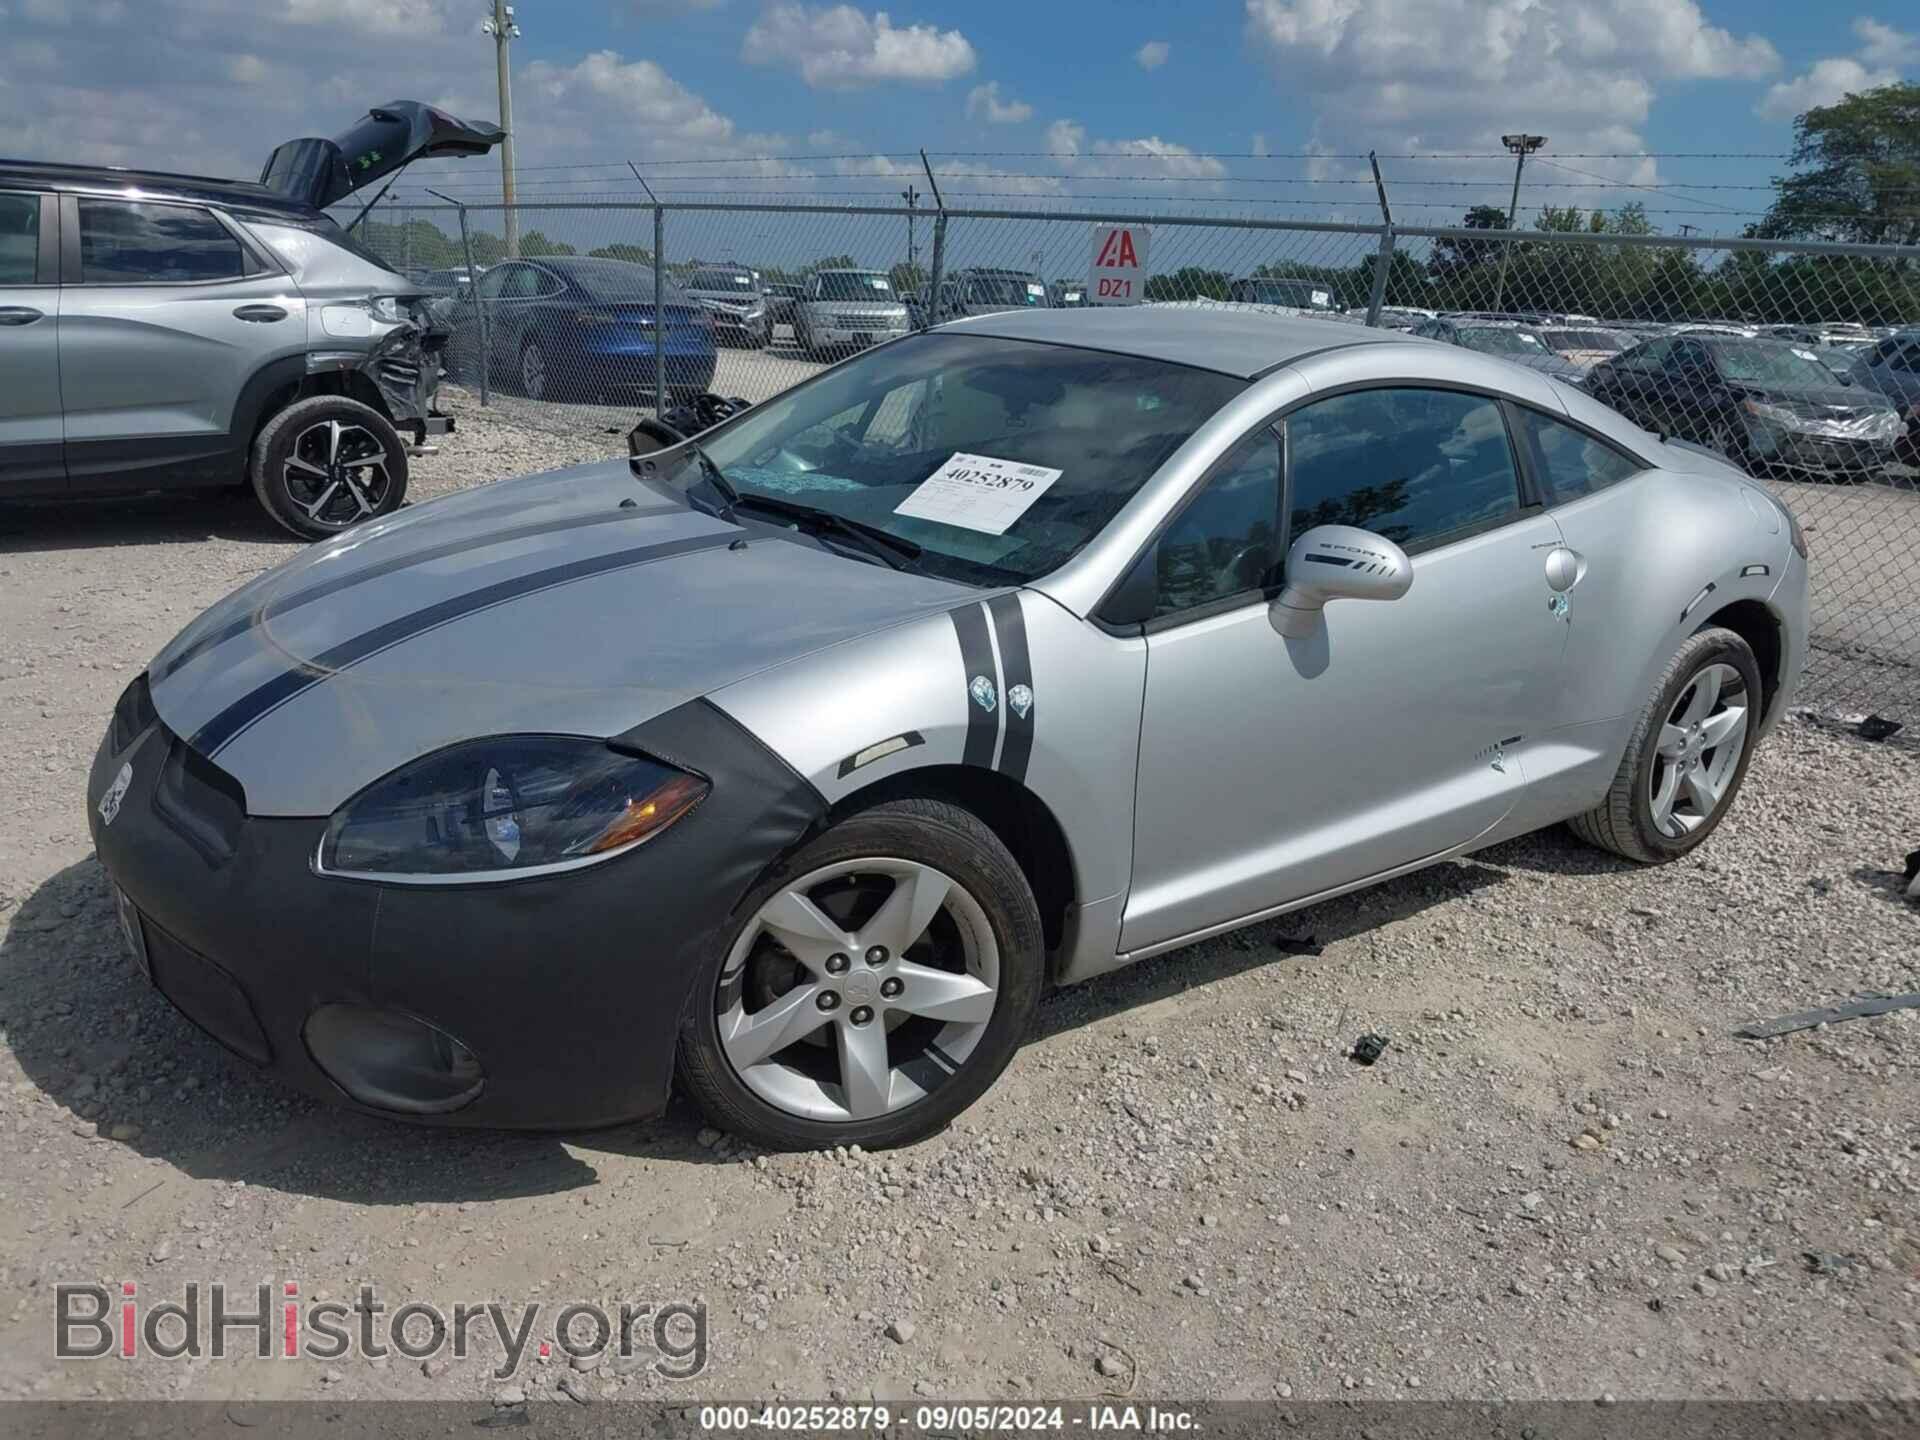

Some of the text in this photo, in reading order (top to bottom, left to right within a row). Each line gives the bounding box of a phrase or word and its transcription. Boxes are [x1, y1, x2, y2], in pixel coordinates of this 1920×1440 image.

[1098, 278, 1131, 298] DZ1
[945, 467, 1036, 493] 40252879
[1319, 542, 1390, 561] SPORT
